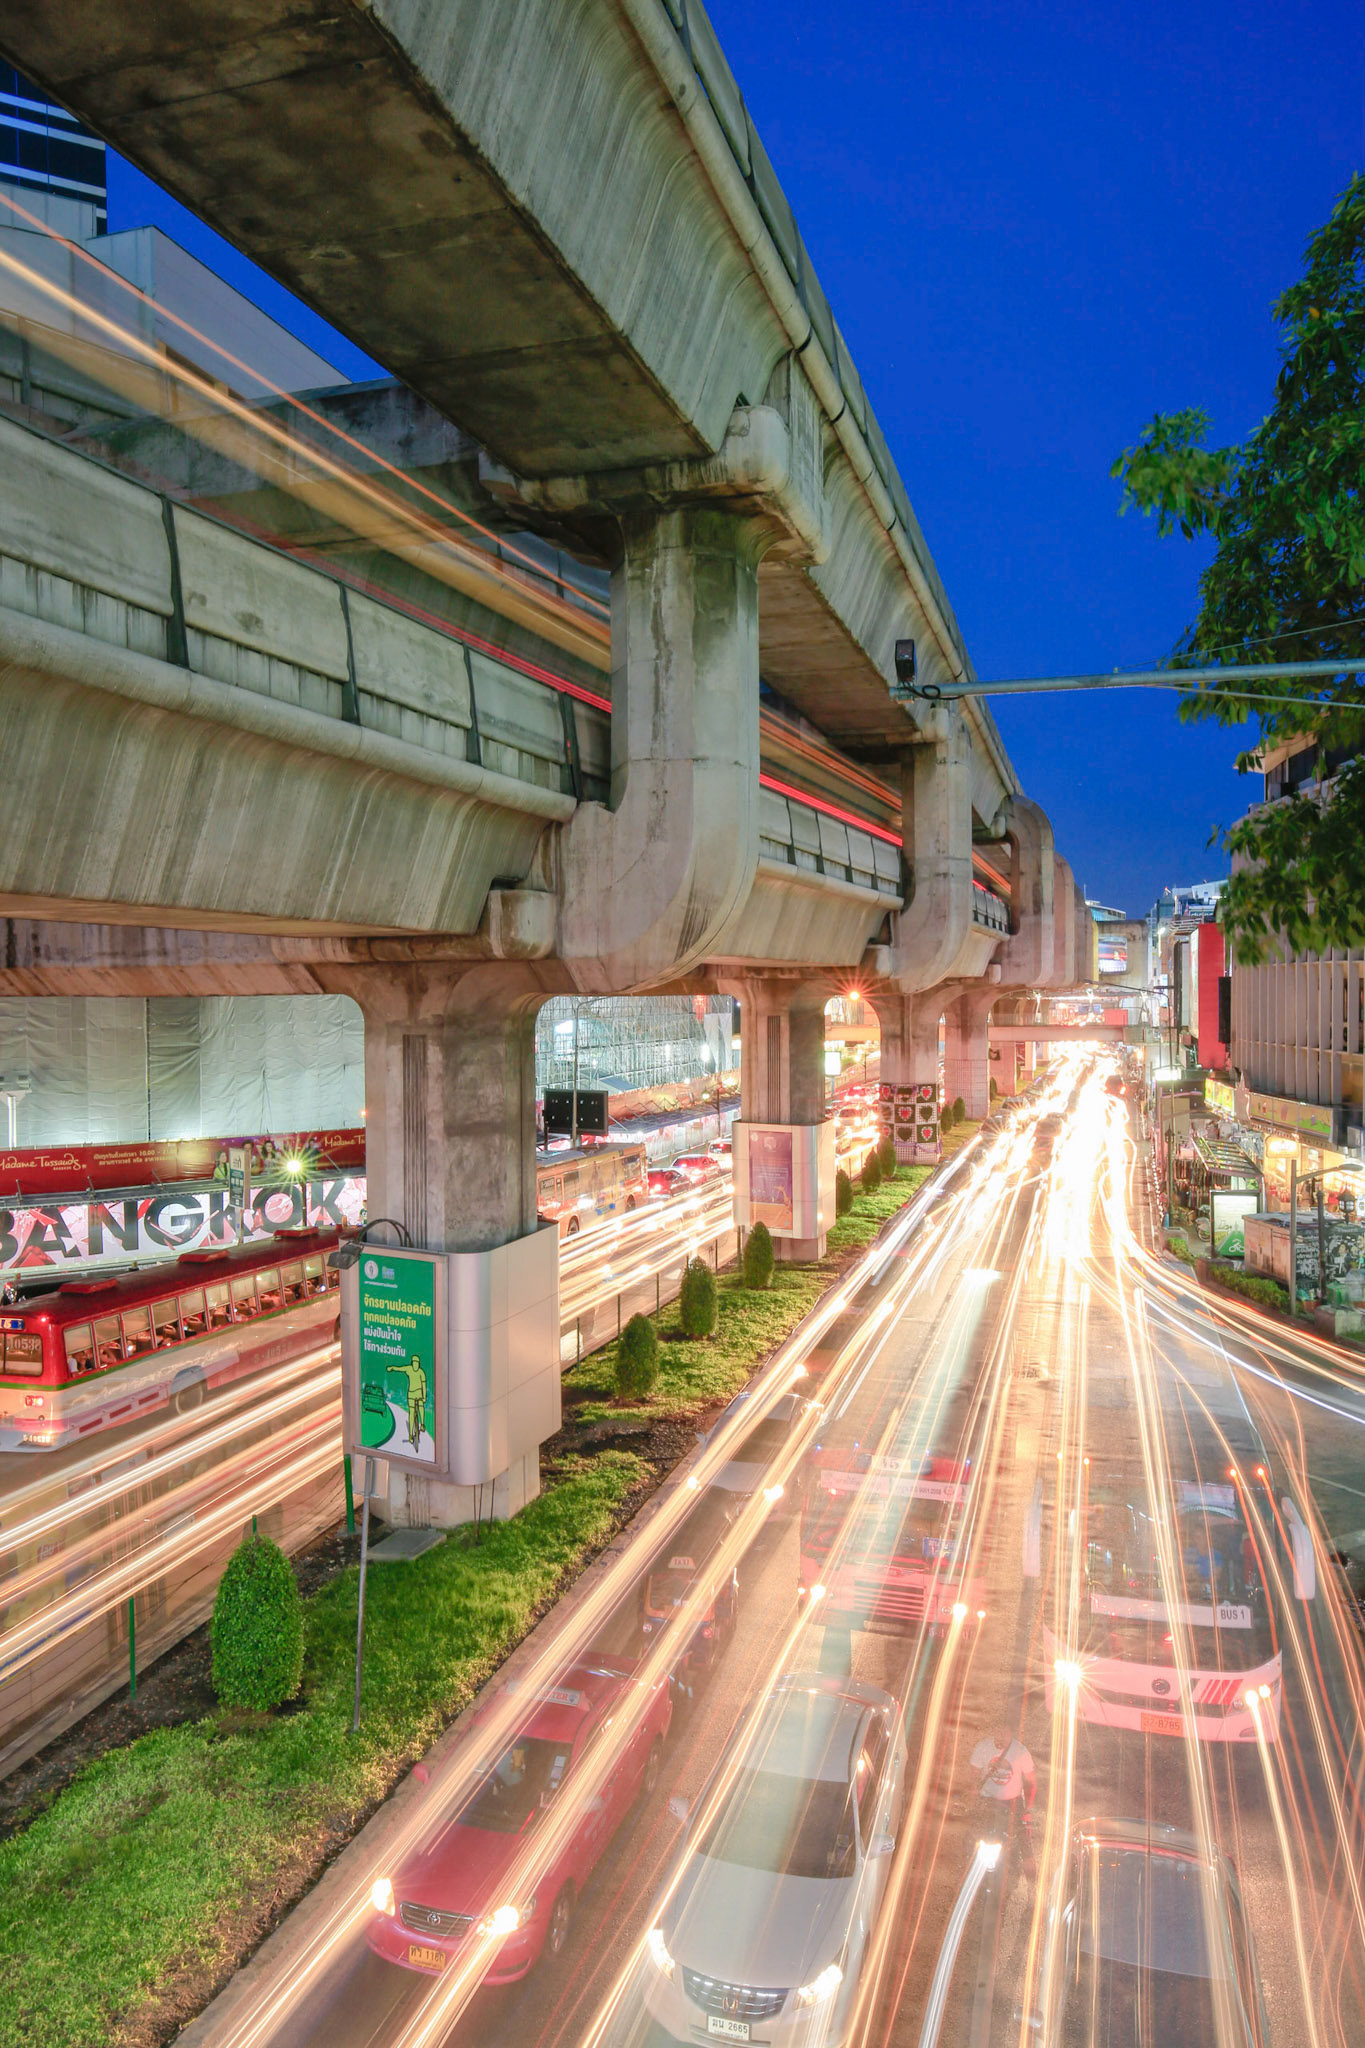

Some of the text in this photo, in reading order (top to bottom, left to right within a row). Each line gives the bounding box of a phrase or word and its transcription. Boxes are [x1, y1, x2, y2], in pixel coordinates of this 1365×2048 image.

[364, 1293, 432, 1317] จักรยานปลอดภัย
[364, 1311, 417, 1329] ทุกคนปลอดภัย
[1220, 1609, 1245, 1620] BUS 1
[728, 2022, 748, 2034] 2665
